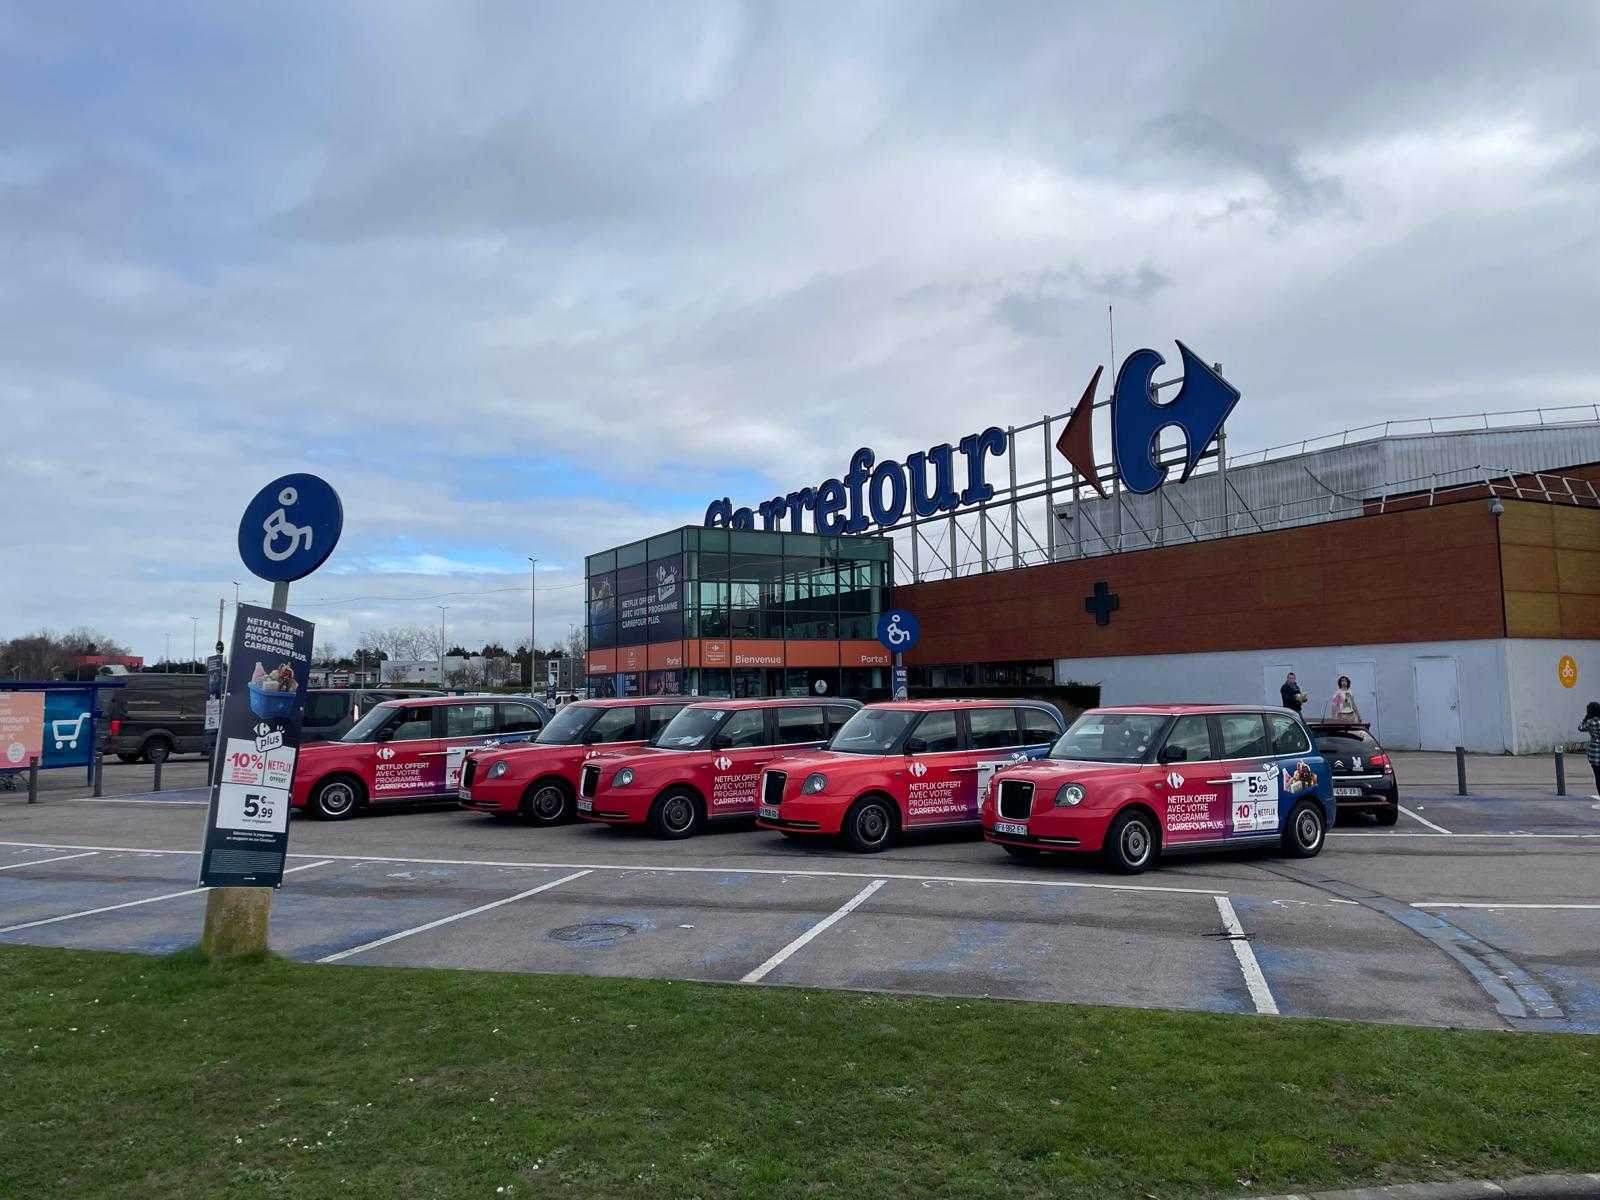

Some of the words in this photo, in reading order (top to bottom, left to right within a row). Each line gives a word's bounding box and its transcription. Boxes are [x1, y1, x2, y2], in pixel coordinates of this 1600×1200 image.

[246, 616, 281, 630] NETFLIX
[281, 624, 305, 638] OFFERT
[246, 625, 270, 637] AVEC
[270, 629, 294, 642] VOTRE
[245, 632, 295, 650] PROGRAMME
[244, 641, 291, 658] CARREFOUR
[735, 654, 781, 664] Bienvenue
[861, 655, 883, 663] Porte
[260, 734, 280, 751] plus
[226, 752, 264, 770] -10%
[267, 759, 293, 774] NETFLIX
[376, 763, 404, 771] NETFLIX
[404, 762, 430, 770] OFFERT
[269, 775, 288, 784] OFFERT
[375, 776, 422, 784] PROGRAMME
[714, 774, 741, 783] NETFLIX
[375, 782, 417, 790] CARREFOUR
[714, 782, 733, 791] AVEC
[734, 781, 756, 789] VOTRE
[909, 782, 936, 791] NETFLIX
[936, 780, 961, 789] OFFERT
[909, 791, 928, 799] AVEC
[929, 789, 952, 798] VOTRE
[1167, 795, 1194, 804] NETFLIX
[1194, 793, 1217, 803] OFFERT
[713, 796, 754, 805] CARREFOUR
[909, 797, 954, 807] PROGRAMME
[909, 805, 950, 815] CARREFOUR
[1167, 804, 1185, 813] AVEC
[1186, 803, 1209, 812] VOTRE
[1167, 812, 1210, 822] PROGRAMME
[1167, 821, 1206, 831] CARREFOUR
